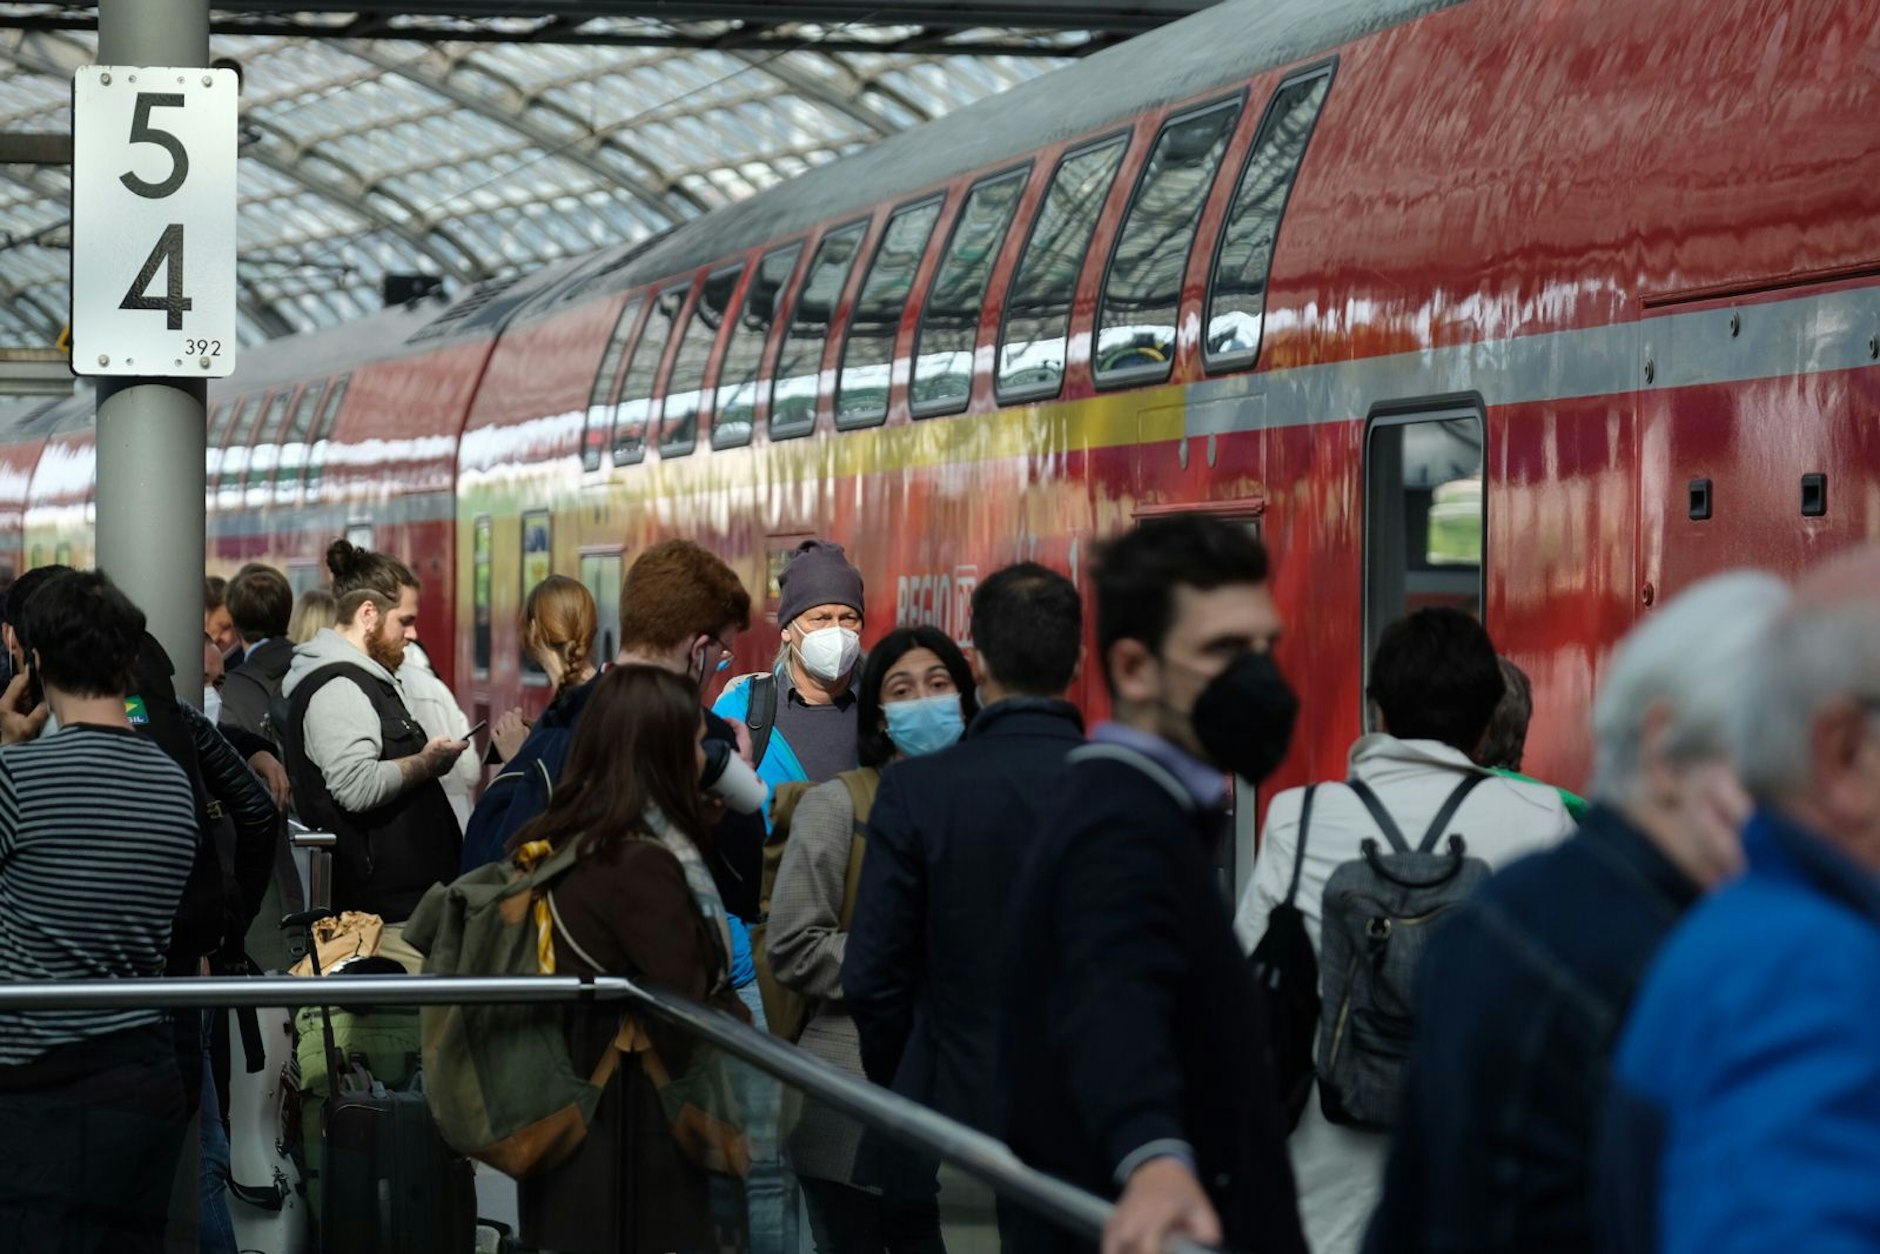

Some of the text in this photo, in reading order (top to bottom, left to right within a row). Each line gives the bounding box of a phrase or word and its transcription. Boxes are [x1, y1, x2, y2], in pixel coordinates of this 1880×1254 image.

[118, 91, 190, 200] 5
[118, 223, 192, 330] 4
[185, 338, 221, 356] 392
